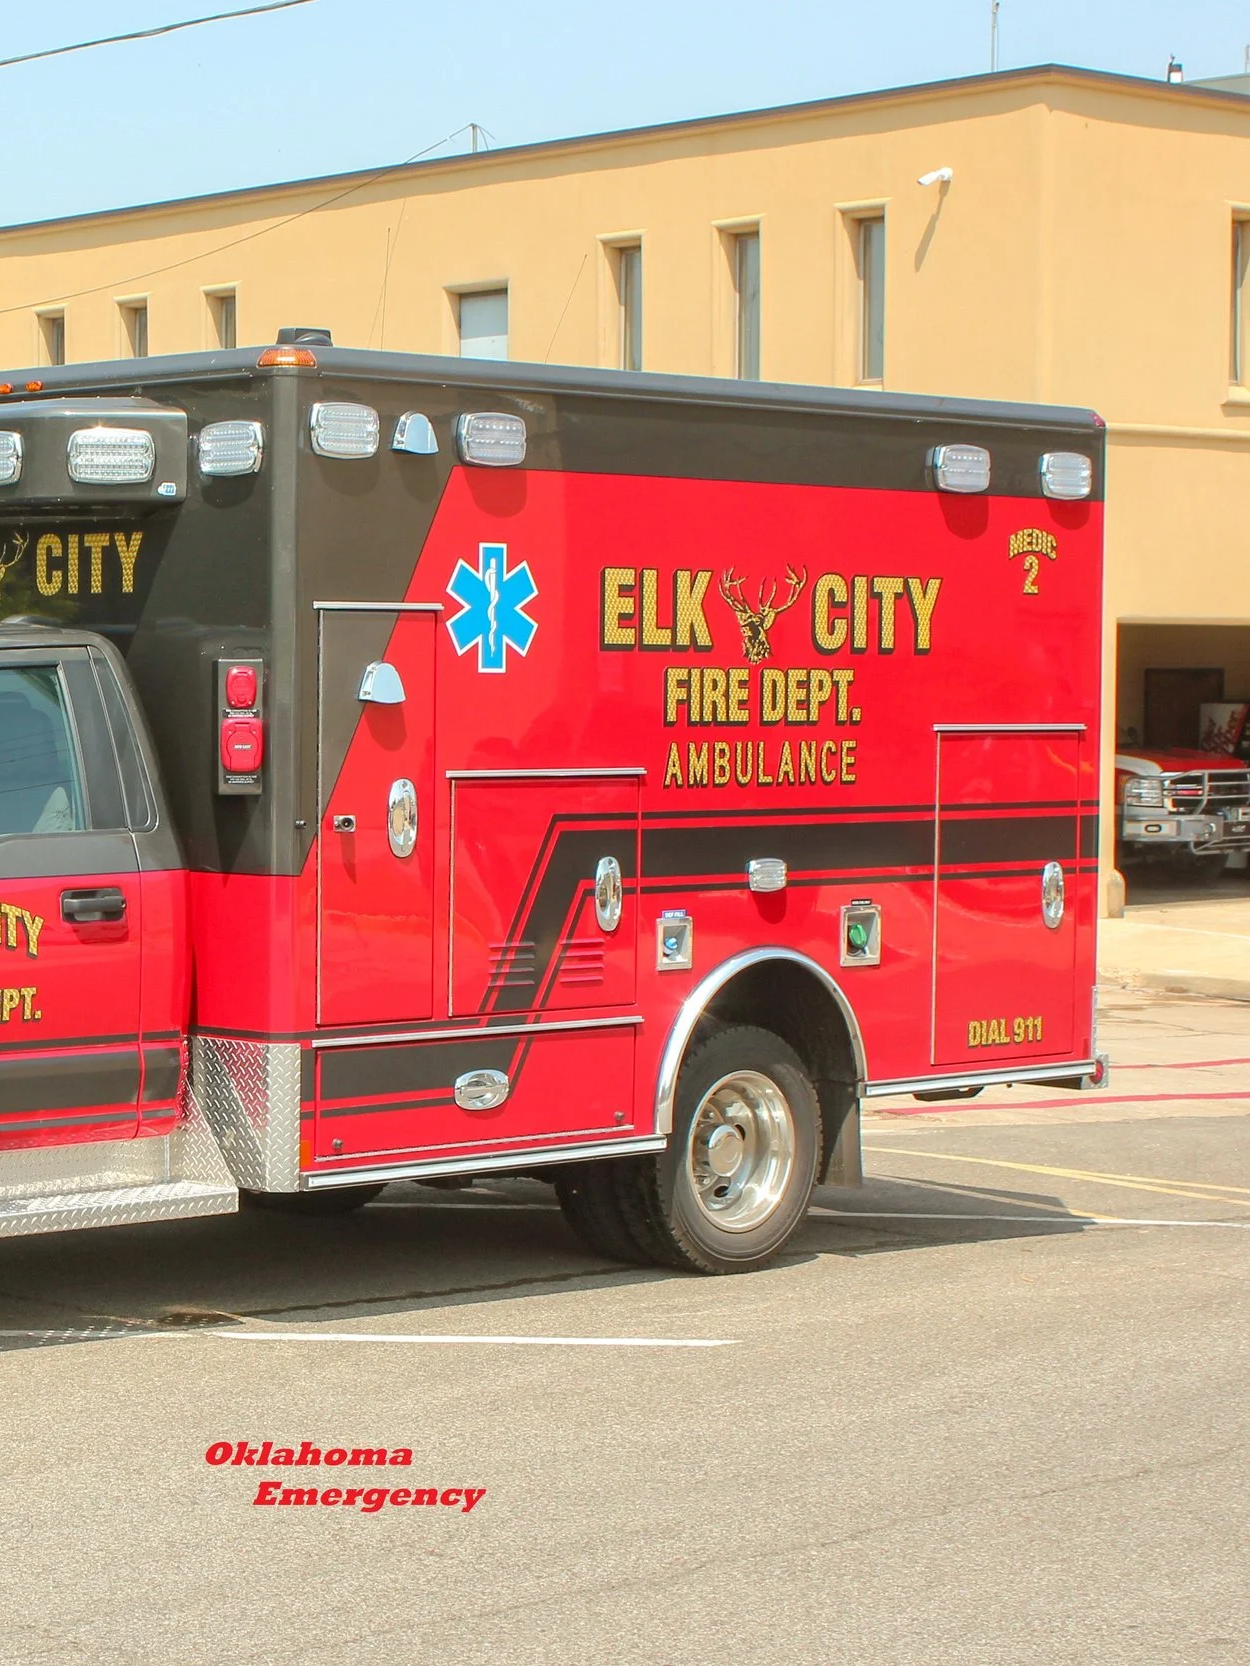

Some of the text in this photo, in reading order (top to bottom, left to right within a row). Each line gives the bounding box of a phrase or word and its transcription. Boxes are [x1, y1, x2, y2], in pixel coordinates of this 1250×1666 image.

[36, 531, 144, 597] CITY
[1008, 528, 1058, 561] MEDIC
[1022, 554, 1040, 595] 2
[600, 566, 943, 654] ELK CITY
[664, 666, 862, 727] FIRE DEPT.
[662, 739, 857, 788] AMBULANCE
[968, 1015, 1043, 1048] DIAL 911
